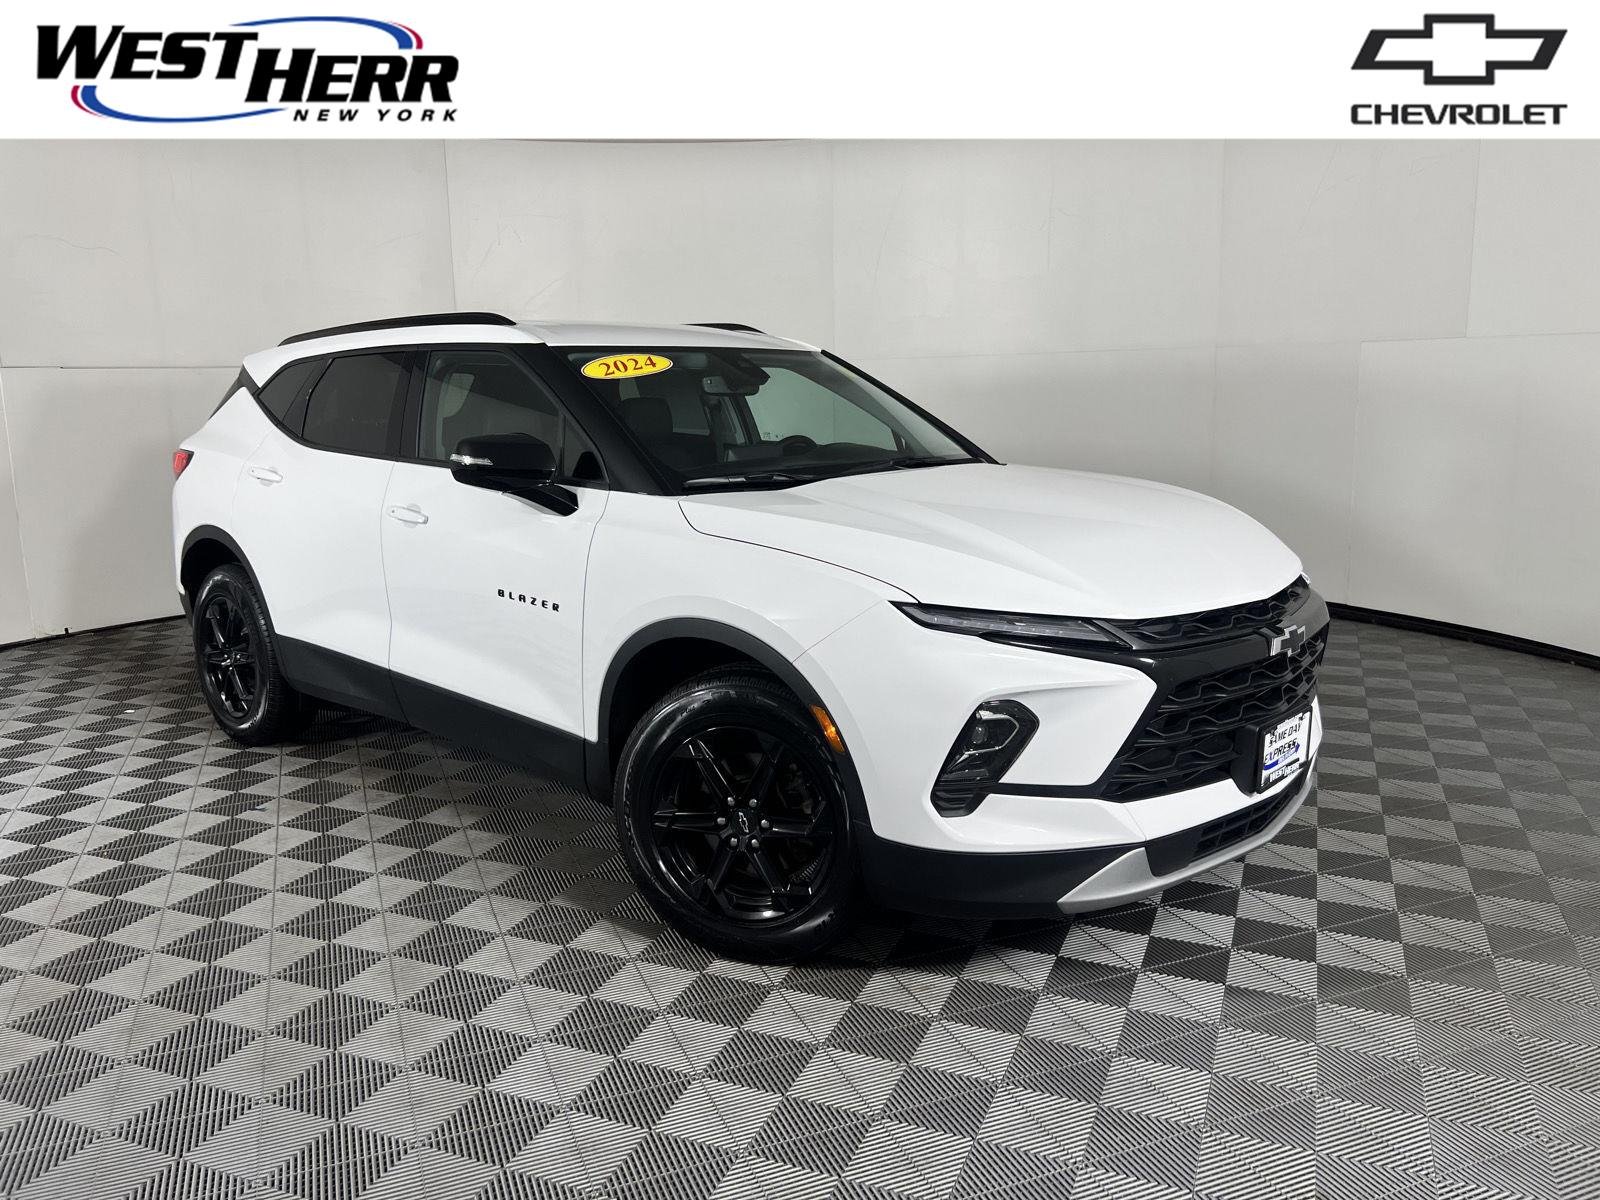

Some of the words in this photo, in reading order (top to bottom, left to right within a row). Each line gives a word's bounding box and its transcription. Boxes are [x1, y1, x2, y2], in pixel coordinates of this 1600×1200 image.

[598, 355, 657, 377] 2024
[497, 588, 560, 613] BLAZER
[1287, 722, 1302, 739] DAY
[1264, 738, 1298, 765] EXPRESS
